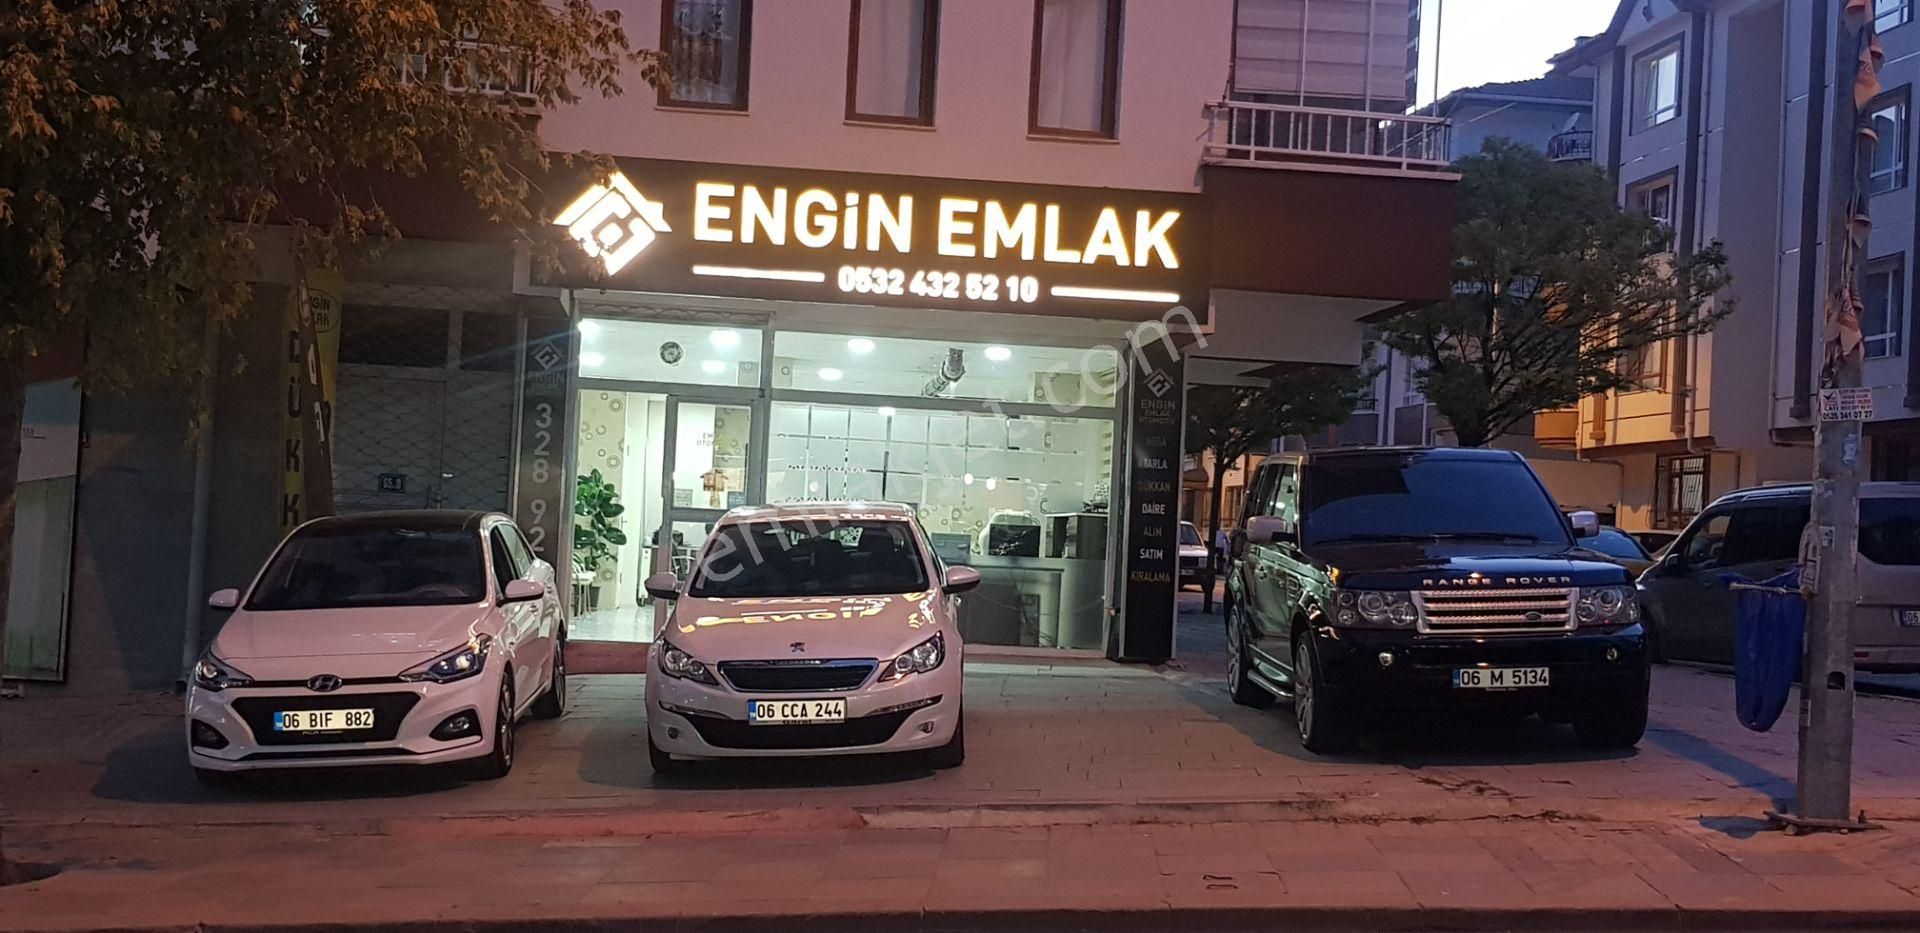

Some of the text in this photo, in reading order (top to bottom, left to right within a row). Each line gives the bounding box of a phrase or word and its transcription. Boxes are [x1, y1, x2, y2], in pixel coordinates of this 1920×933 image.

[938, 197, 1181, 269] EMLAK
[837, 265, 1039, 303] 0532 432 52 10
[533, 403, 552, 483] 328
[1143, 458, 1168, 470] TARLA
[1140, 548, 1164, 560] SATIM
[1422, 576, 1571, 586] RANGE ROVER
[1461, 669, 1547, 686] 06 M 5134
[757, 702, 842, 718] 06 CCA 244
[283, 711, 371, 728] 06 BIF 882
